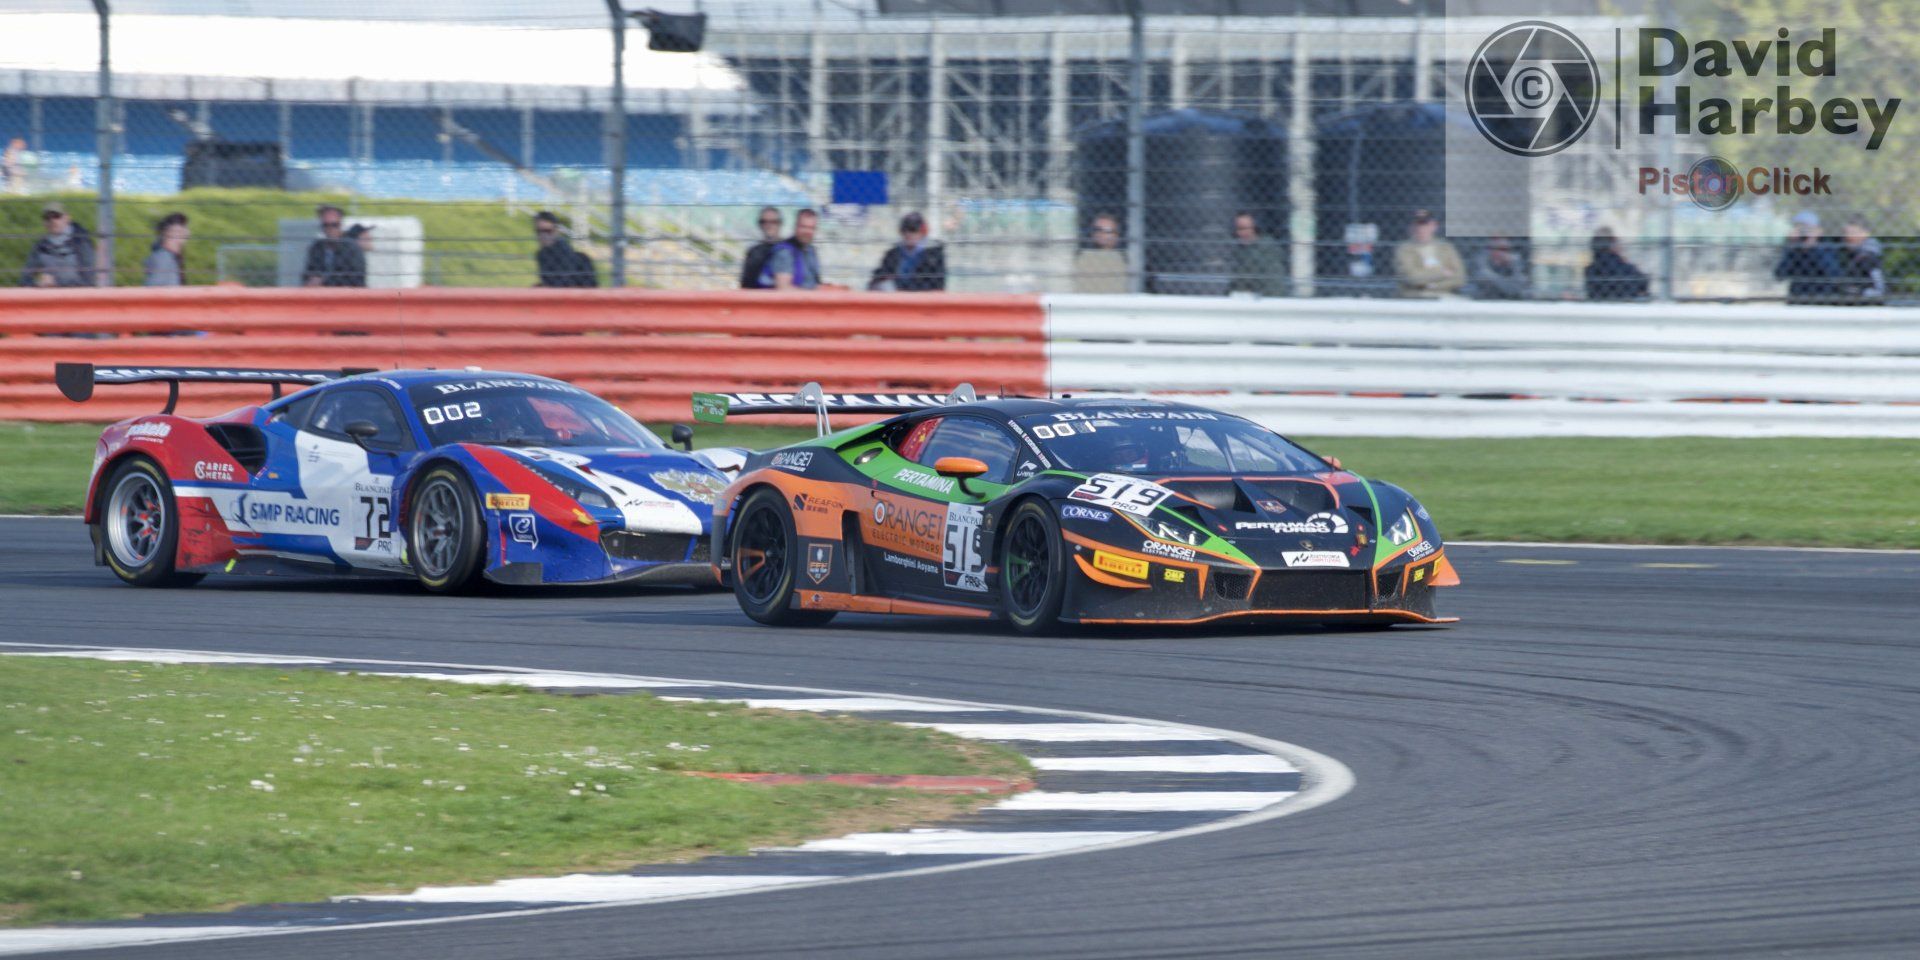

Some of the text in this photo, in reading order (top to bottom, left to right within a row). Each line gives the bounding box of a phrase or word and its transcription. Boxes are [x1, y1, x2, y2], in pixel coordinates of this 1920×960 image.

[434, 380, 582, 395] BLANCPAIN
[423, 401, 482, 425] 002
[1051, 411, 1218, 421] BLANCPAIN
[1033, 419, 1096, 439] 001
[355, 482, 391, 494] BLANCPAI
[893, 469, 954, 495] PERTAMINA
[1078, 478, 1166, 506] 519
[251, 503, 340, 526] SMP RACING
[1062, 506, 1109, 520] CORNES
[1111, 501, 1138, 511] PRO
[360, 496, 391, 538] 72
[874, 501, 943, 540] ORANGE1
[949, 511, 982, 526] BLANCPAI
[1235, 521, 1328, 530] PERTAMAX
[1143, 540, 1196, 558] ORANGE1
[883, 551, 918, 568] Lamborghini
[1099, 554, 1143, 574] PIRELLI
